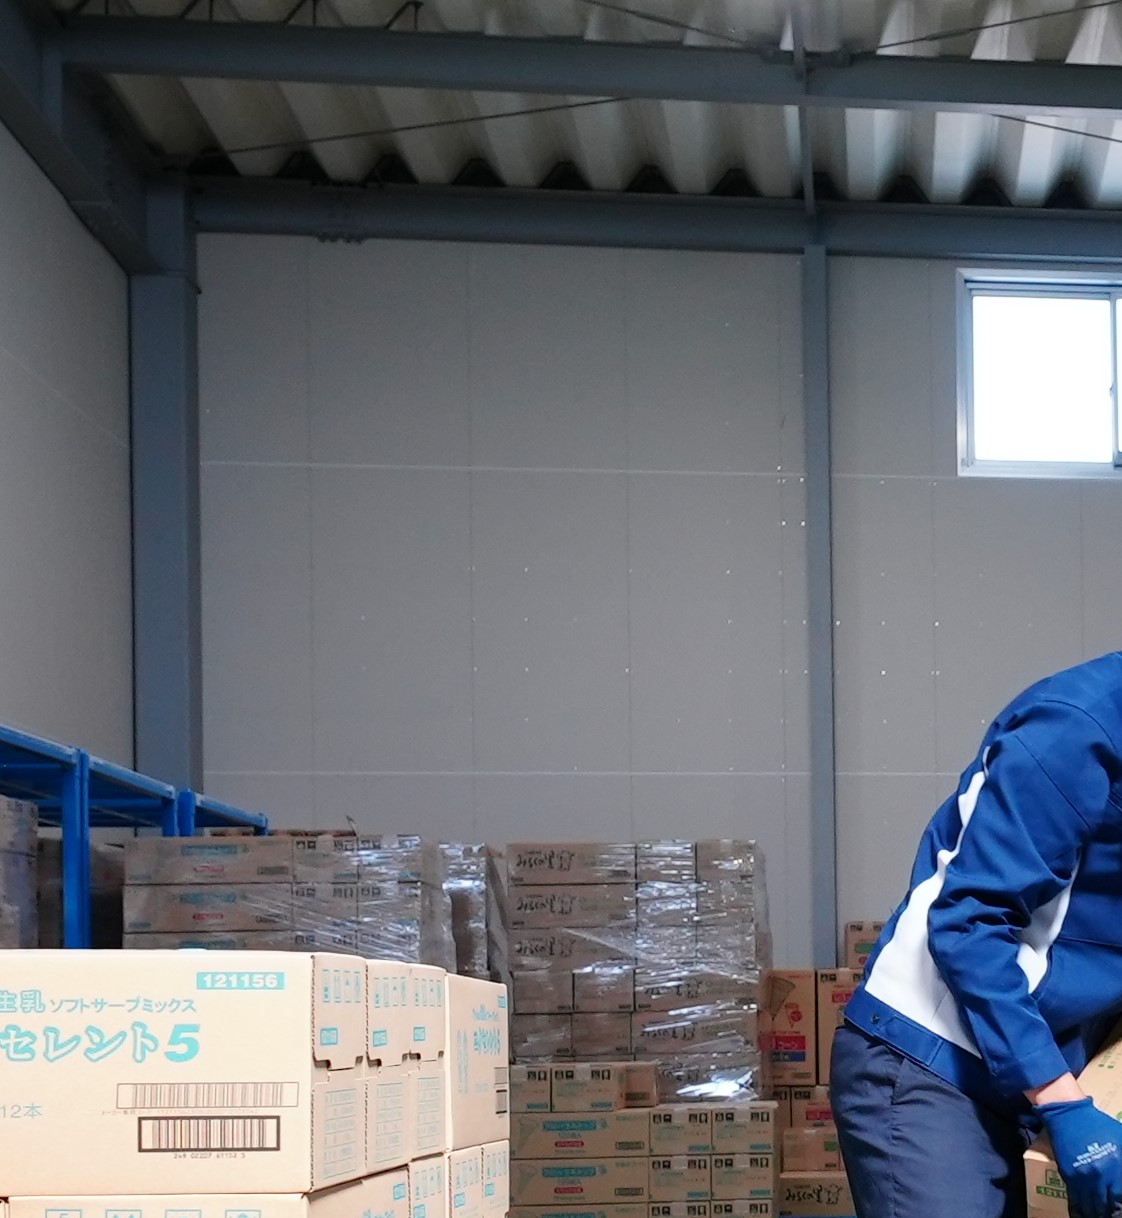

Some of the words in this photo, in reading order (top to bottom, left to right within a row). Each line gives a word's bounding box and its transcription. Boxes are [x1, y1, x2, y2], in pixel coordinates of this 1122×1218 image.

[202, 973, 279, 988] 121156
[50, 997, 196, 1013] ソフトサーブミックス
